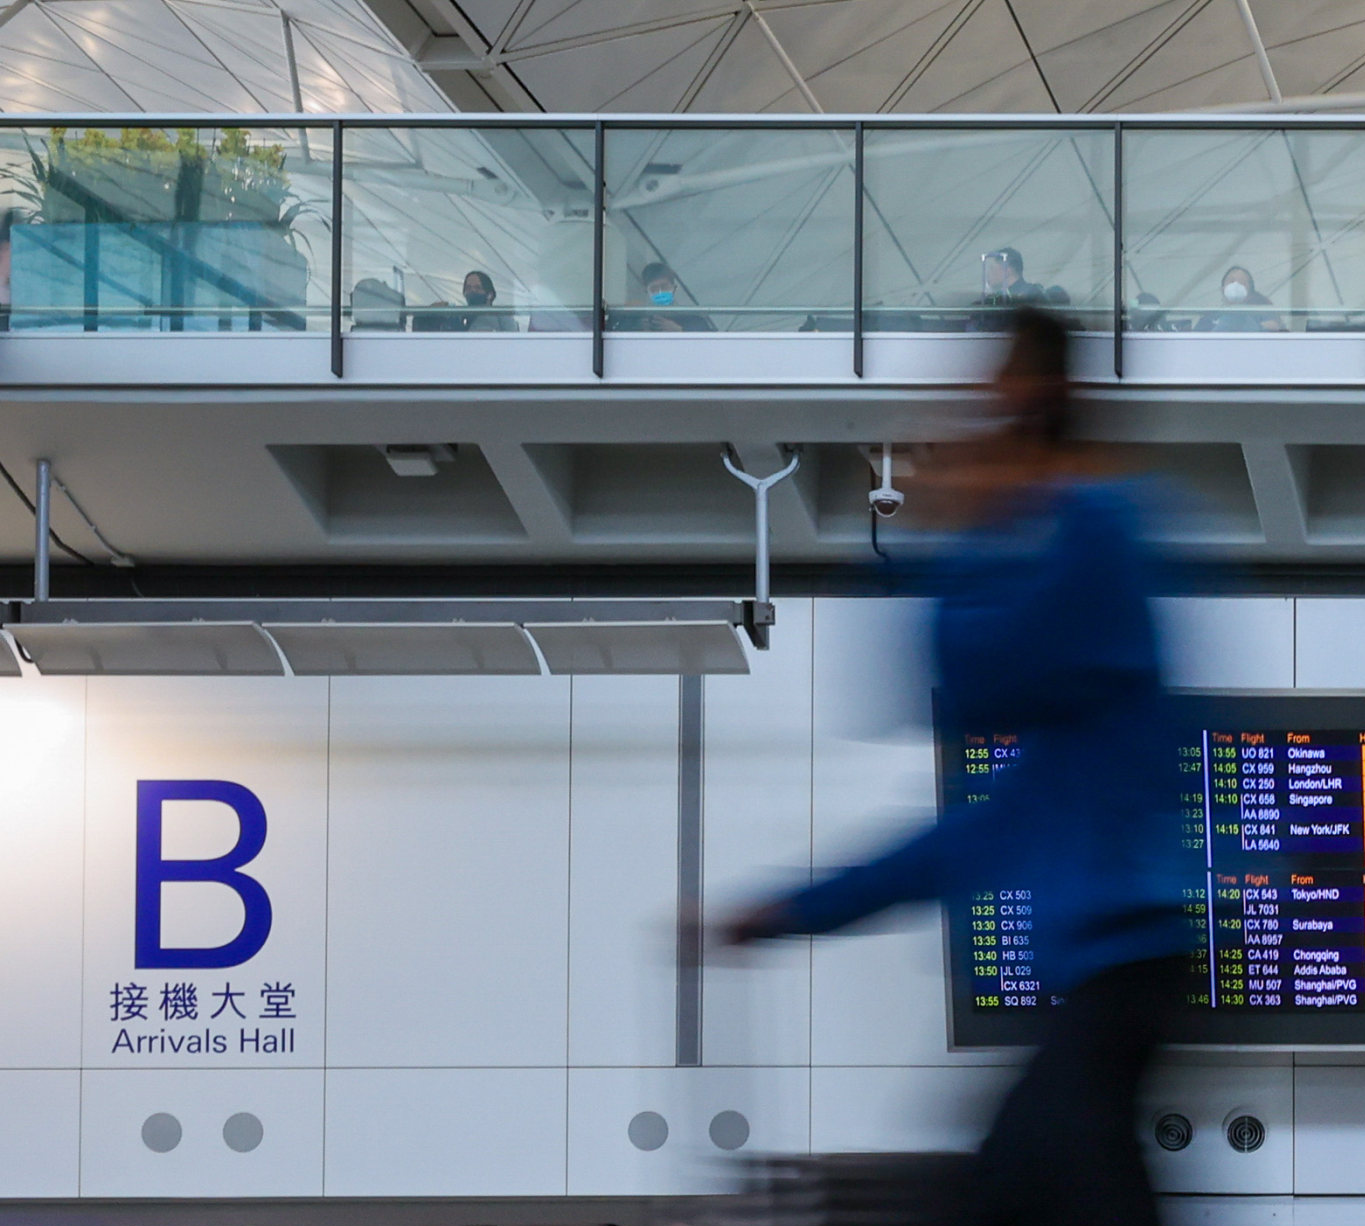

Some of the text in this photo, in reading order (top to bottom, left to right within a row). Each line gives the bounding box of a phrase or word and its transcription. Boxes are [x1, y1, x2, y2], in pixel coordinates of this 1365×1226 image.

[964, 747, 990, 760] 12:55
[1287, 747, 1326, 759] Okinawa
[1287, 762, 1332, 777] Hangzhou
[1214, 777, 1343, 790] 14:10 London/LHR
[1289, 792, 1333, 808] Singapore
[1215, 823, 1350, 836] 14:15 New York/JFK
[134, 778, 273, 970] B
[1291, 888, 1340, 902] Tokyo/HND
[971, 905, 995, 916] 13:25
[1000, 904, 1015, 916] CX
[972, 920, 996, 932] 13:30
[1292, 918, 1334, 933] Surabaya
[972, 935, 997, 946] 13:35
[1293, 948, 1340, 963] Chongqing
[1293, 964, 1347, 976] Addis Ababa
[1294, 978, 1357, 993] Shanghai/PVG
[109, 981, 297, 1023] 接機大堂
[975, 995, 1000, 1007] 13:55
[1295, 993, 1358, 1008] Shanghai/PVG
[111, 1026, 295, 1055] Arrivals Hall
